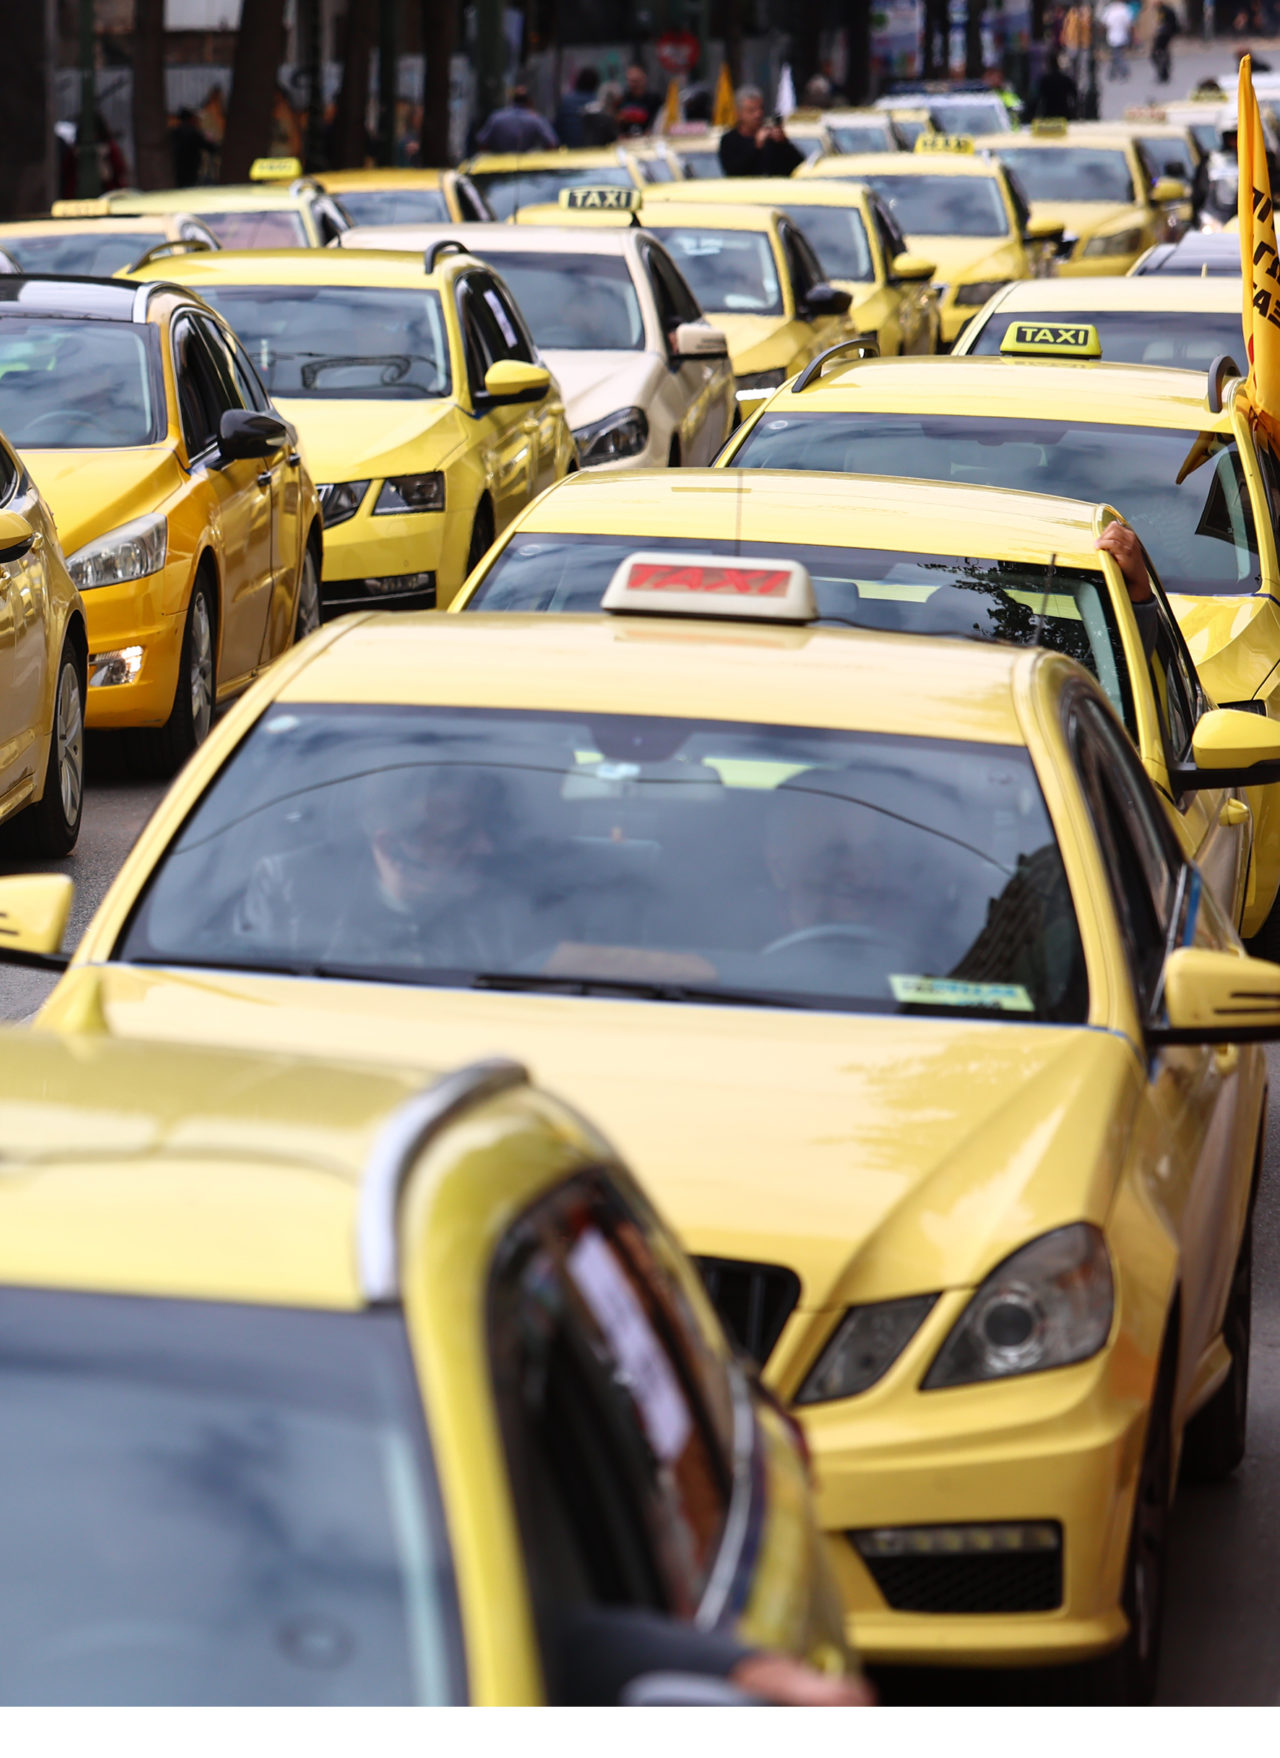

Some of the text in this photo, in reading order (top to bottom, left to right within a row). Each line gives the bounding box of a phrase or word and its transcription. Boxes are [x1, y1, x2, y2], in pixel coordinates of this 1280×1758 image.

[572, 190, 627, 209] TAXI
[1021, 327, 1086, 345] TAXI
[628, 563, 792, 594] TAXI
